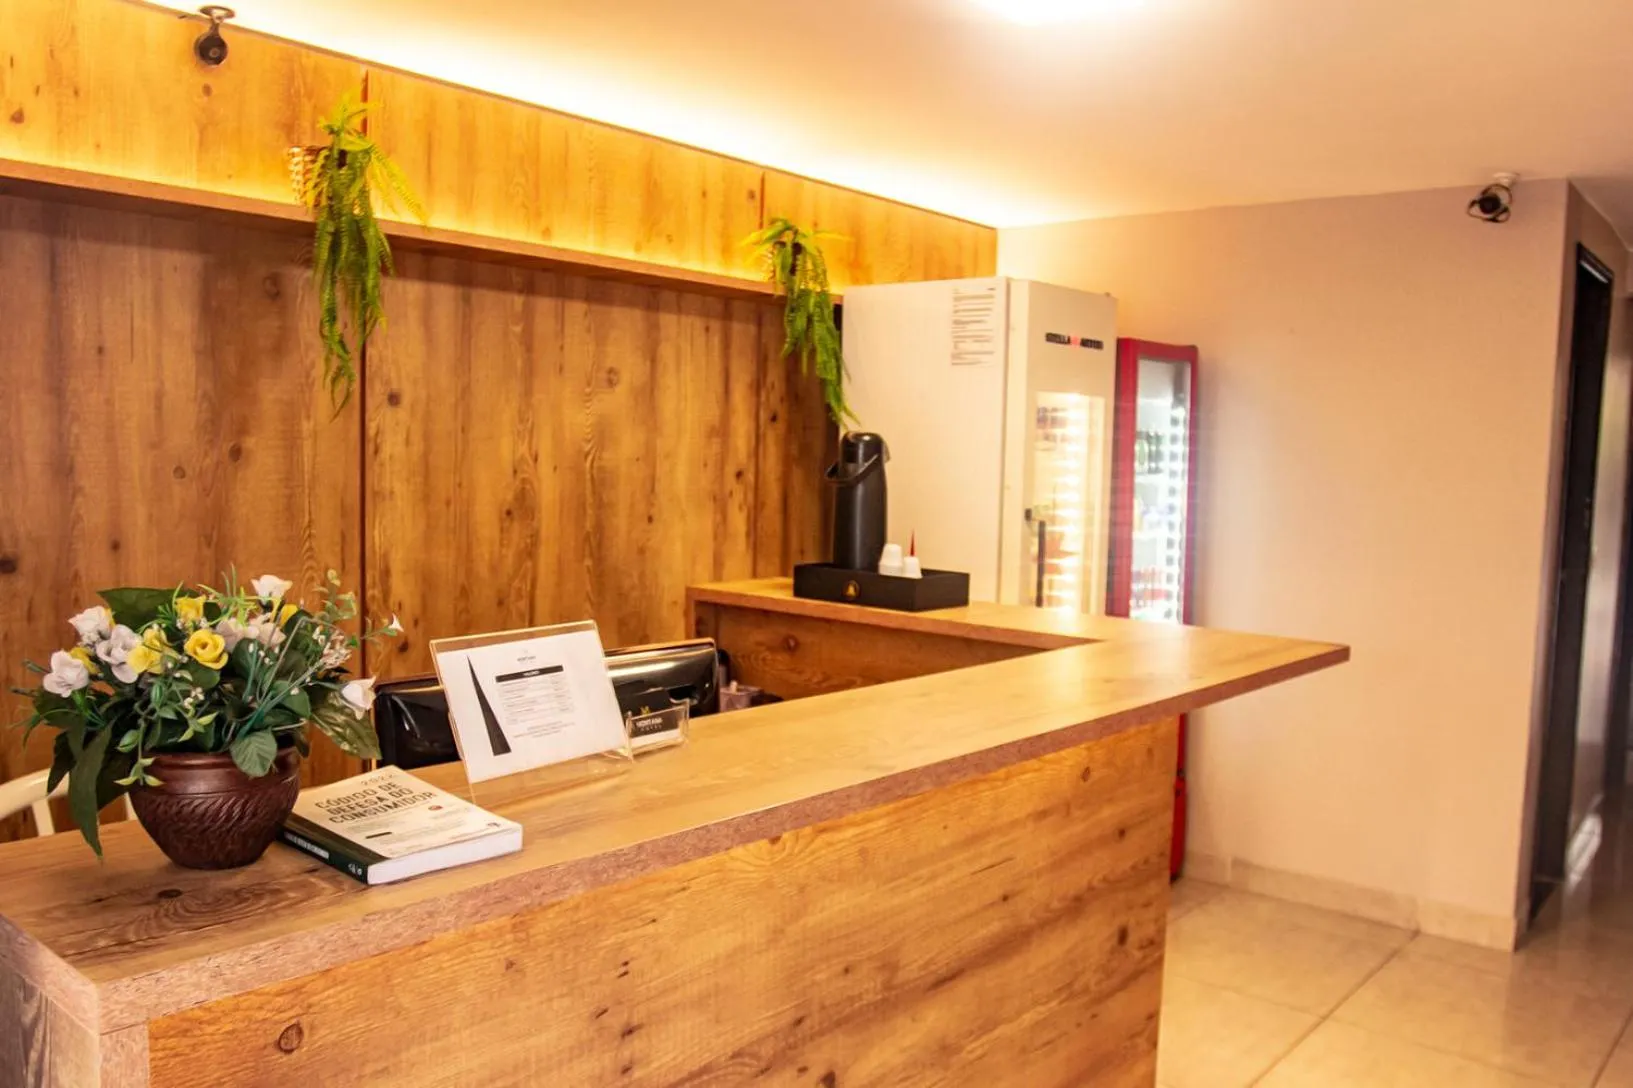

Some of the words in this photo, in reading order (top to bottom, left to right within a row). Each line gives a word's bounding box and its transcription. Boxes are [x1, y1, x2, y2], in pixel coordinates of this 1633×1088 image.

[327, 795, 389, 815] DEFESA
[388, 787, 414, 798] DO
[378, 782, 402, 792] DE
[329, 791, 435, 823] CONSUMIDOR
